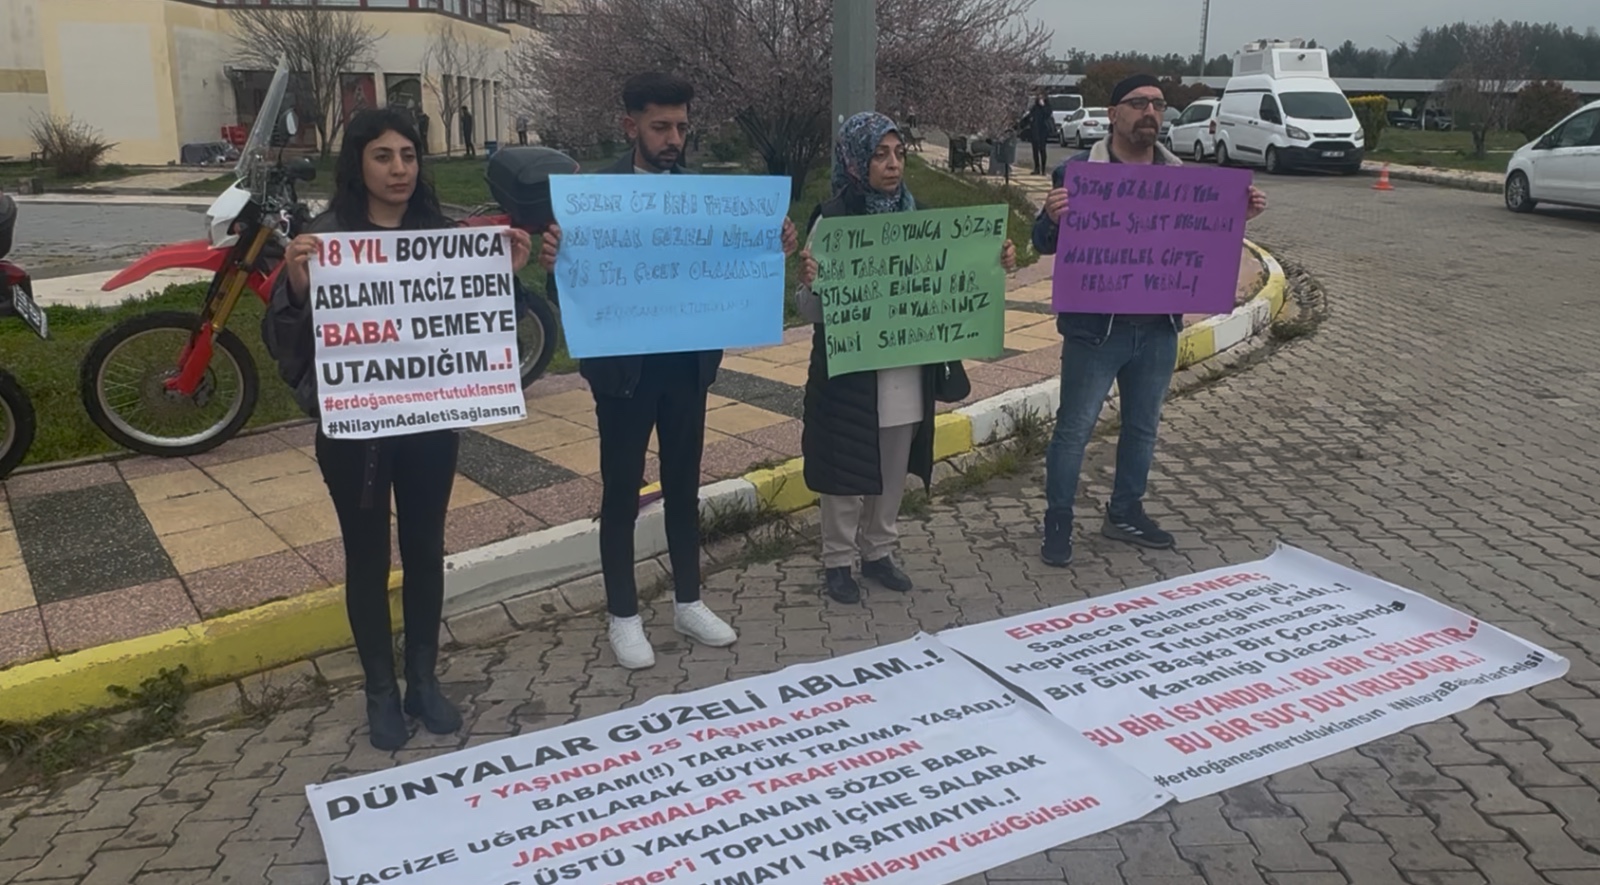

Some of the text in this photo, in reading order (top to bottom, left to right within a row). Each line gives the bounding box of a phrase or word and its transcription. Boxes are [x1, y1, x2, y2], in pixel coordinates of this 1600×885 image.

[631, 191, 656, 213] ÖZ
[822, 215, 1004, 253] 18 YIL BOYUNCA SÖZDE
[318, 233, 505, 267] 18 YIL BOYUNCA
[851, 249, 947, 278] TARAFINDAN
[950, 270, 979, 294] BİR
[315, 271, 511, 310] ABLAMI TACİZ EDEN
[411, 309, 514, 340] DEMEYE
[889, 292, 990, 319] DUYMADINIZ
[322, 347, 513, 386] UTANDIĞIM..!
[324, 382, 517, 412] #erdoğanesmertutuklansın
[328, 404, 521, 435] #NilayınAdaletiSağlansın
[1004, 596, 1160, 640] ERDOĞAN
[1005, 636, 1141, 674] Hepimizin
[1141, 602, 1271, 640] Geleceğini
[1027, 582, 1298, 653] Sadece Ablamın Değil,
[1072, 602, 1345, 678] Şimdi Tutuklanmazsa,
[1043, 680, 1087, 702] Bir
[1091, 667, 1152, 691] Gün
[1149, 647, 1237, 675] Başka
[1232, 634, 1276, 653] Bir
[1119, 712, 1175, 737] BİR
[1290, 666, 1332, 687] BU
[1323, 656, 1377, 676] BİR
[1139, 659, 1267, 700] Karanlığı
[326, 649, 945, 821] DÜNYALAR GÜZELİ ABLAM..!
[464, 693, 877, 808] 7 YAŞINDAN 25 YAŞINA KADAR
[1153, 707, 1387, 788] #erdoğanesmertutuklansın
[1165, 731, 1213, 755] BU
[1204, 719, 1263, 743] BİR
[1250, 702, 1314, 730] SUÇ
[532, 718, 851, 811] BABAM(!!) TARAFINDAN
[333, 849, 459, 885] TACİZE
[467, 780, 692, 854] UĞRATILARAK
[696, 751, 797, 788] BÜYÜK
[800, 723, 911, 760] TRAVMA
[512, 740, 924, 868] JANDARMALAR TARAFINDAN
[533, 745, 997, 885] ÜSTÜ YAKALANAN SÖZDE BABA
[701, 816, 832, 865] TOPLUM
[832, 792, 918, 824] İÇİNE
[919, 754, 1046, 799] SALARAK
[808, 787, 1022, 862] YAŞATMAYIN..!
[823, 795, 1100, 885] #NilayınYüzüGülsün
